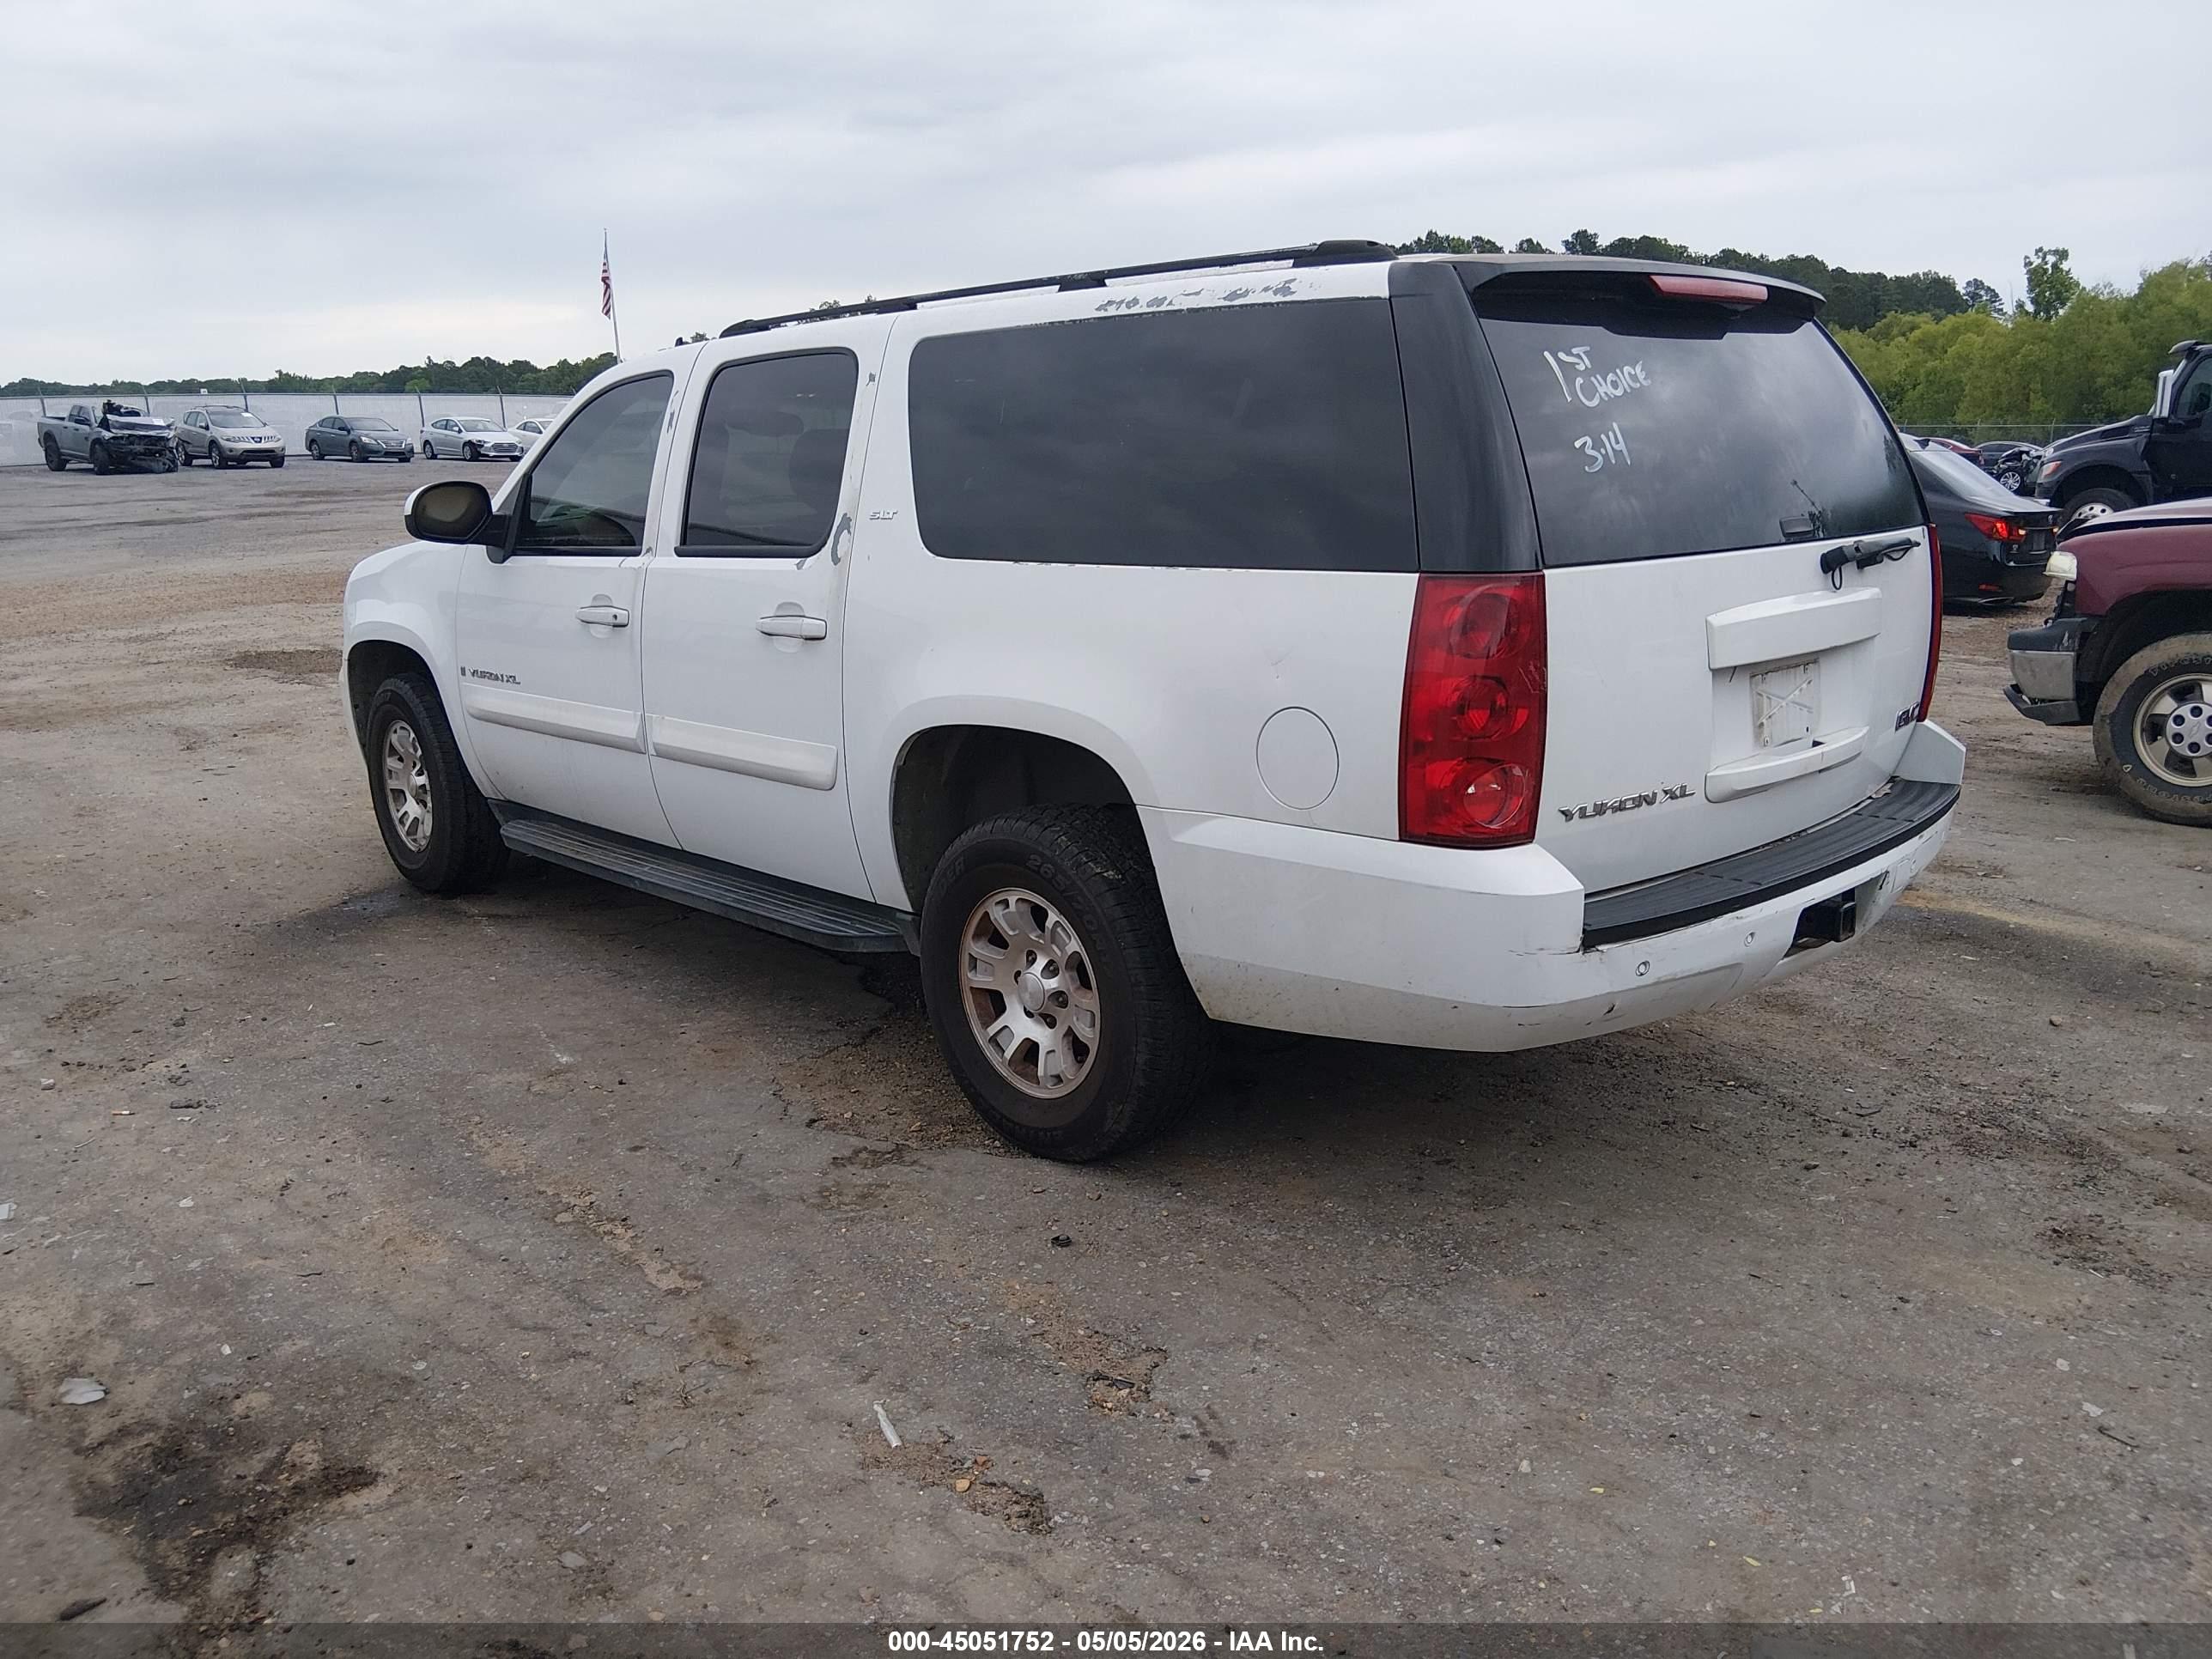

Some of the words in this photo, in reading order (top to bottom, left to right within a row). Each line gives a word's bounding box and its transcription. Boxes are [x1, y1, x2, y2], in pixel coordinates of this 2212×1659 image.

[1575, 361, 1652, 408] CHOICE
[869, 509, 899, 520] SLT
[468, 667, 505, 683] YUKON
[505, 674, 521, 685] XL
[1558, 789, 1658, 823] YUKON
[1659, 782, 1697, 805] XL
